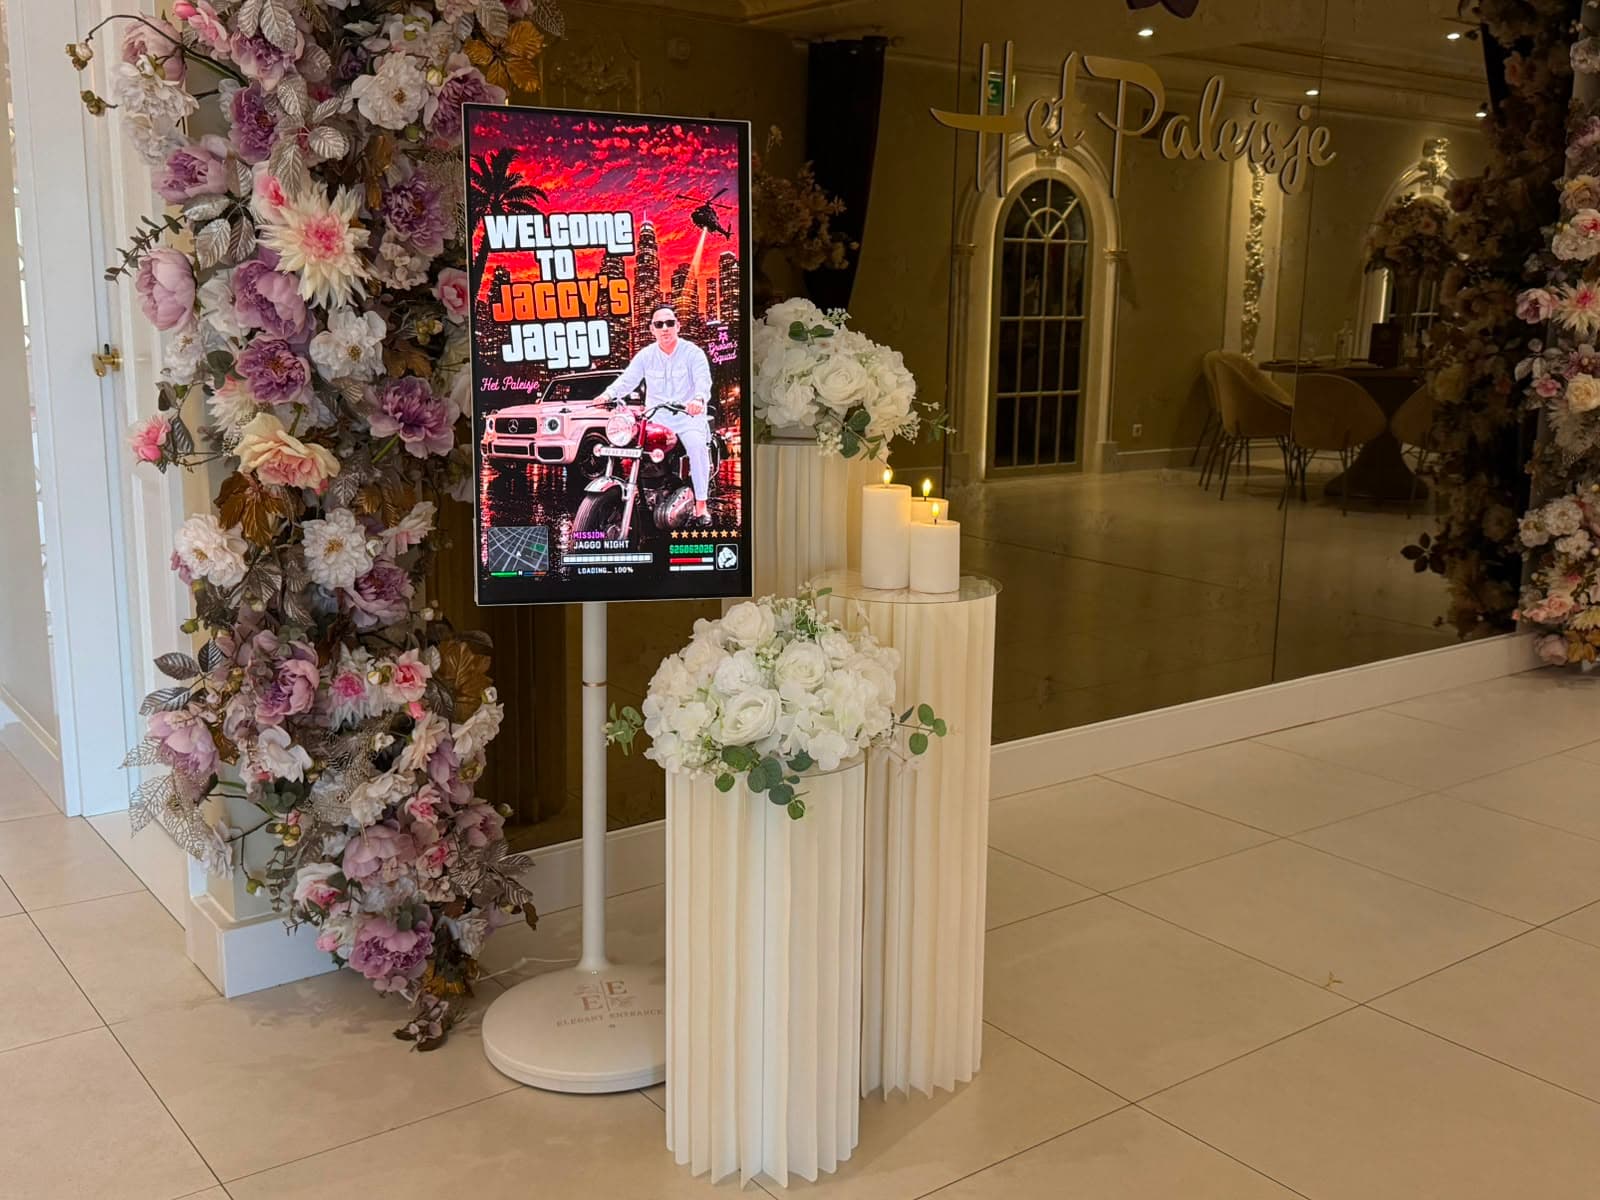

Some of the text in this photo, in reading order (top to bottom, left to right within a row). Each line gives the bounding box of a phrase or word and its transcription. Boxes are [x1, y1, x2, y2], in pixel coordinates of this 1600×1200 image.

[930, 40, 1336, 198] Het Paleisje
[536, 249, 575, 281] TO
[480, 375, 540, 394] Het Paleisje
[573, 531, 605, 539] MISSION
[573, 540, 630, 549] JAGGO NIGHT
[614, 566, 634, 574] 100%
